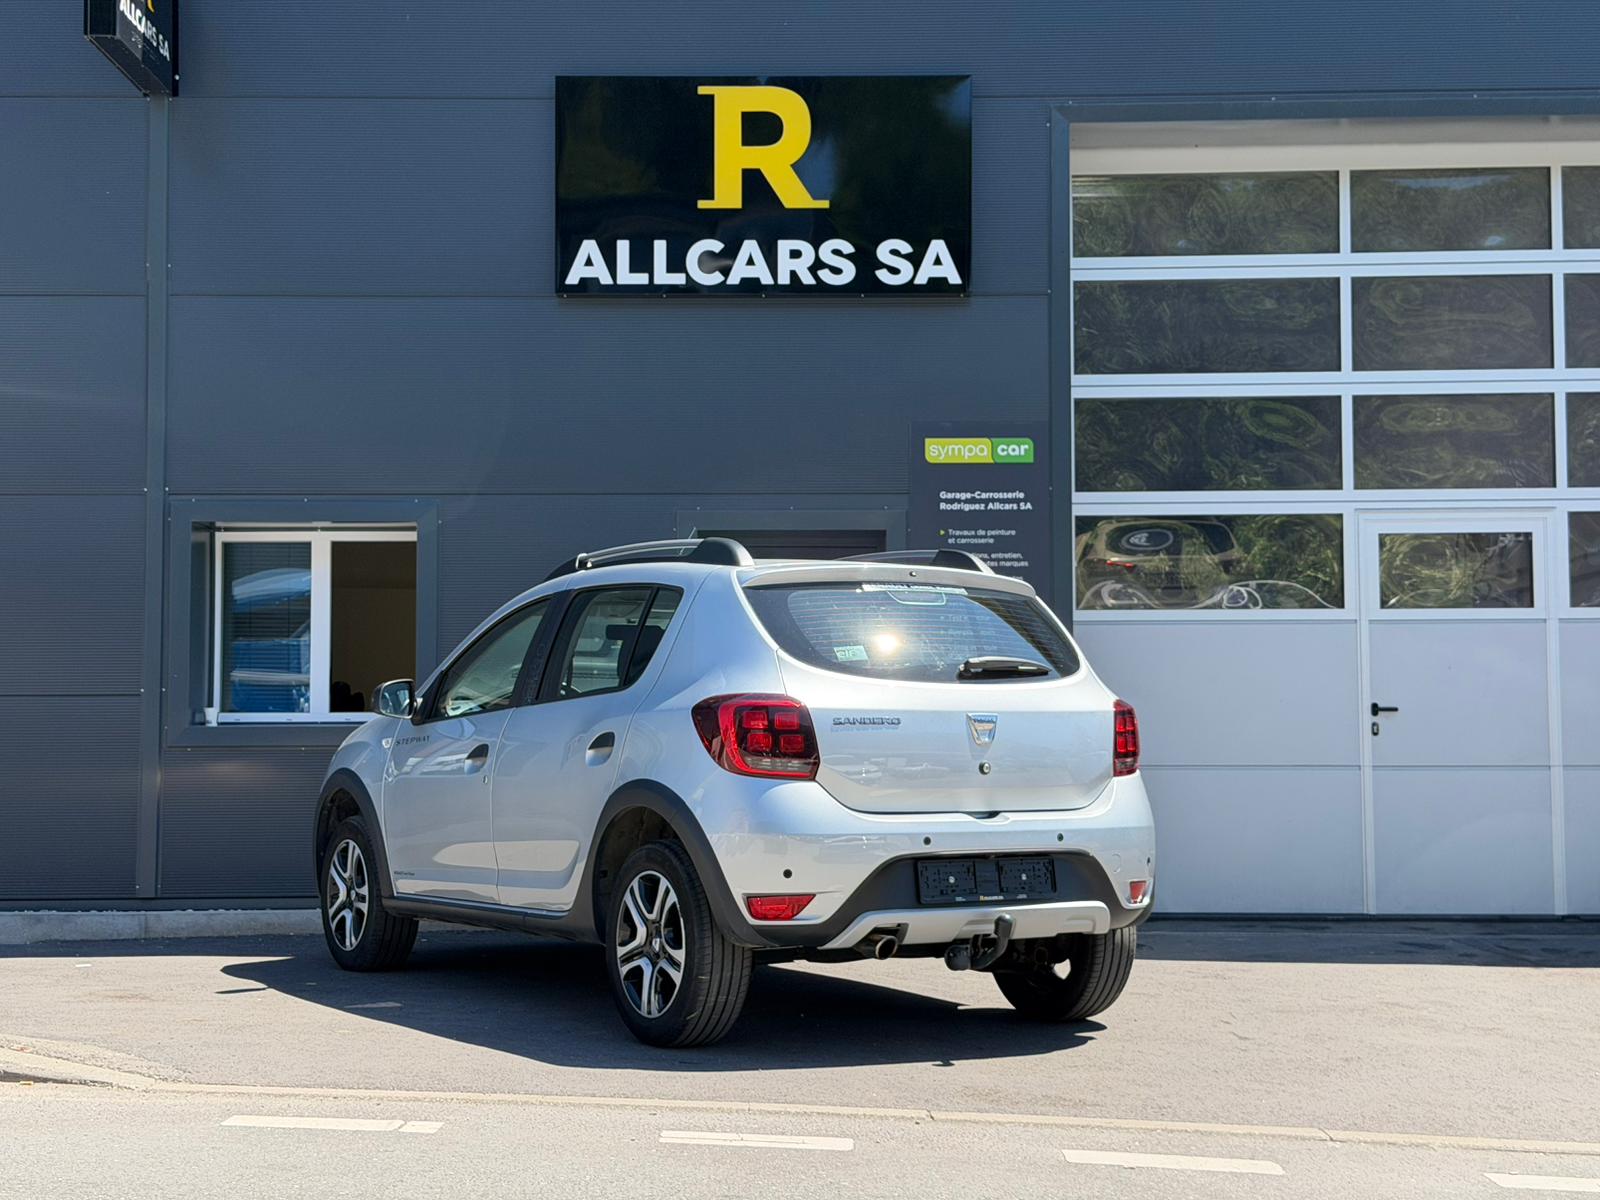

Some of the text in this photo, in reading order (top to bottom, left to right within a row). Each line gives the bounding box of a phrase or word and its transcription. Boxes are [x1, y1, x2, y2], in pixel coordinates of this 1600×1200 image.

[158, 34, 170, 61] SA
[697, 85, 830, 209] R
[564, 238, 963, 286] ALLCARS SA
[929, 444, 1029, 460] sympa car
[939, 490, 1025, 500] Garage-Carrosserie
[939, 502, 1033, 511] Rodriguez Allcars SA
[987, 529, 1016, 537] peinture
[832, 716, 902, 726] SANDERO
